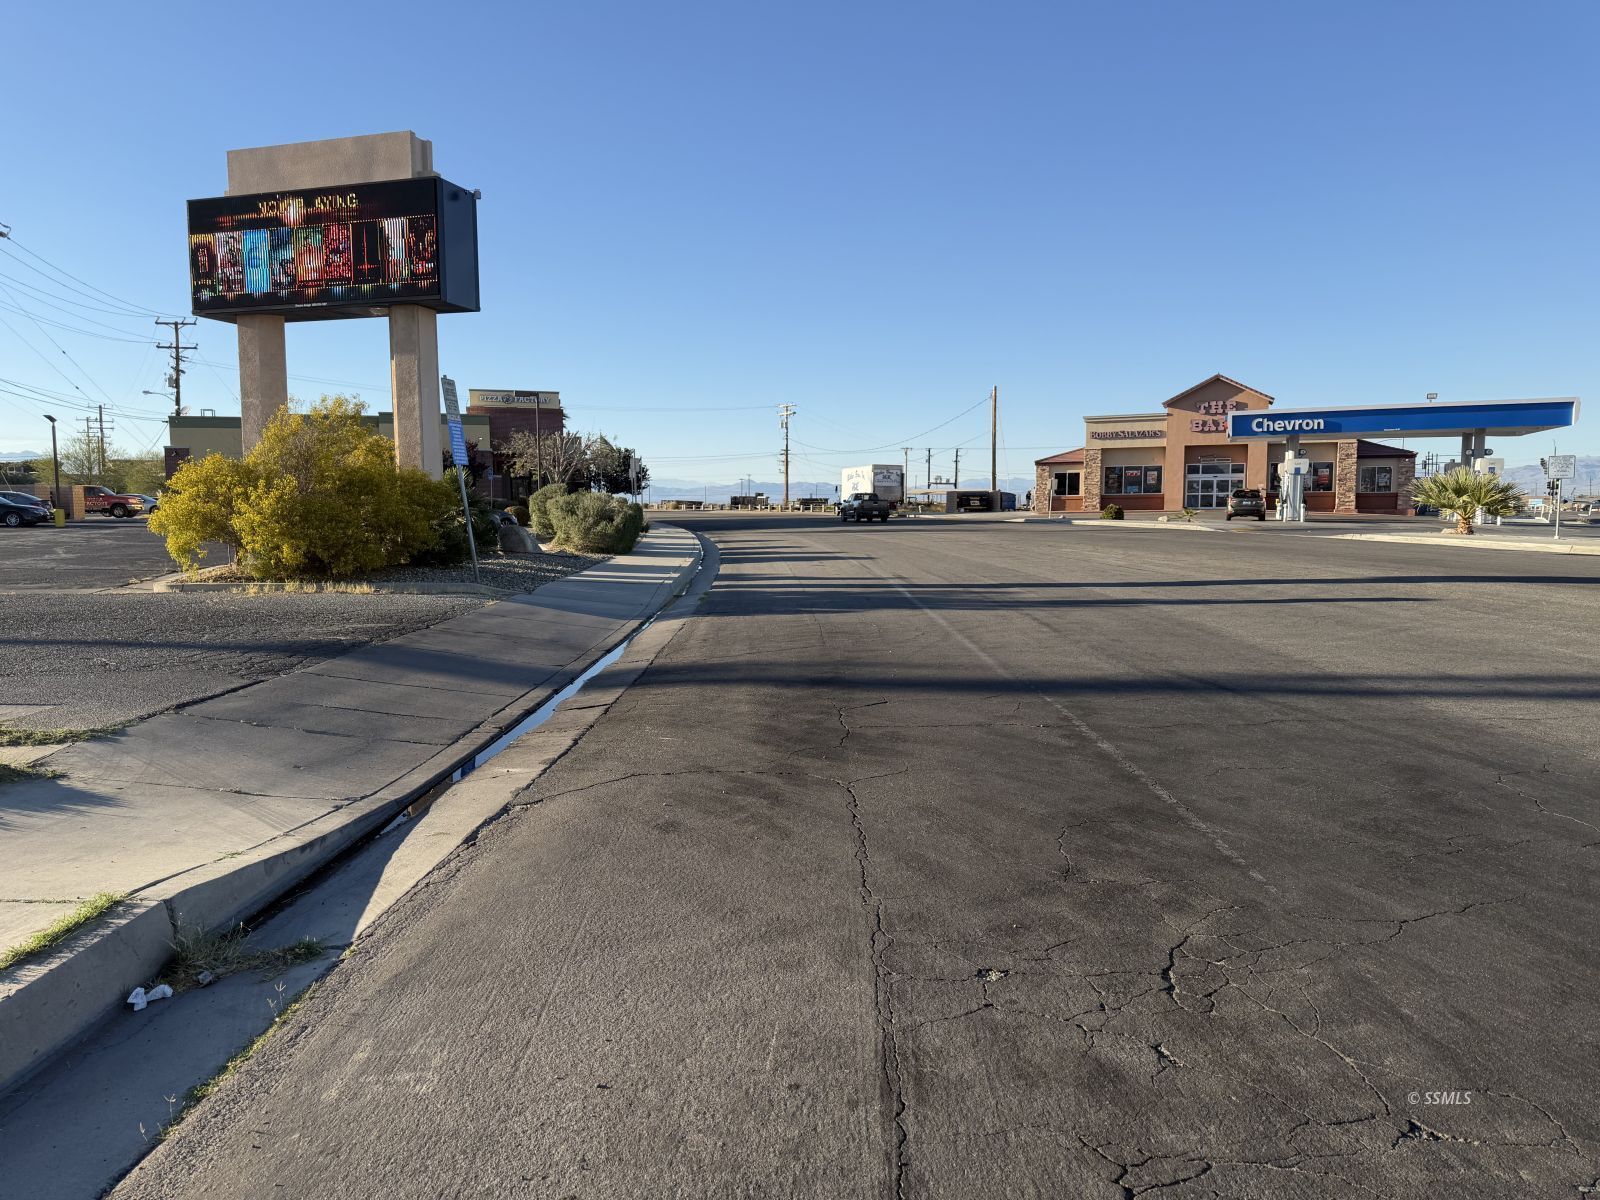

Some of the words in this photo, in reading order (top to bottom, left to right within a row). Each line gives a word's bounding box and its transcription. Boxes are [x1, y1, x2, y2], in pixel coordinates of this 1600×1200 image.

[1197, 400, 1237, 415] THE
[1251, 417, 1325, 432] Chevron
[1090, 431, 1116, 439] BOBBY
